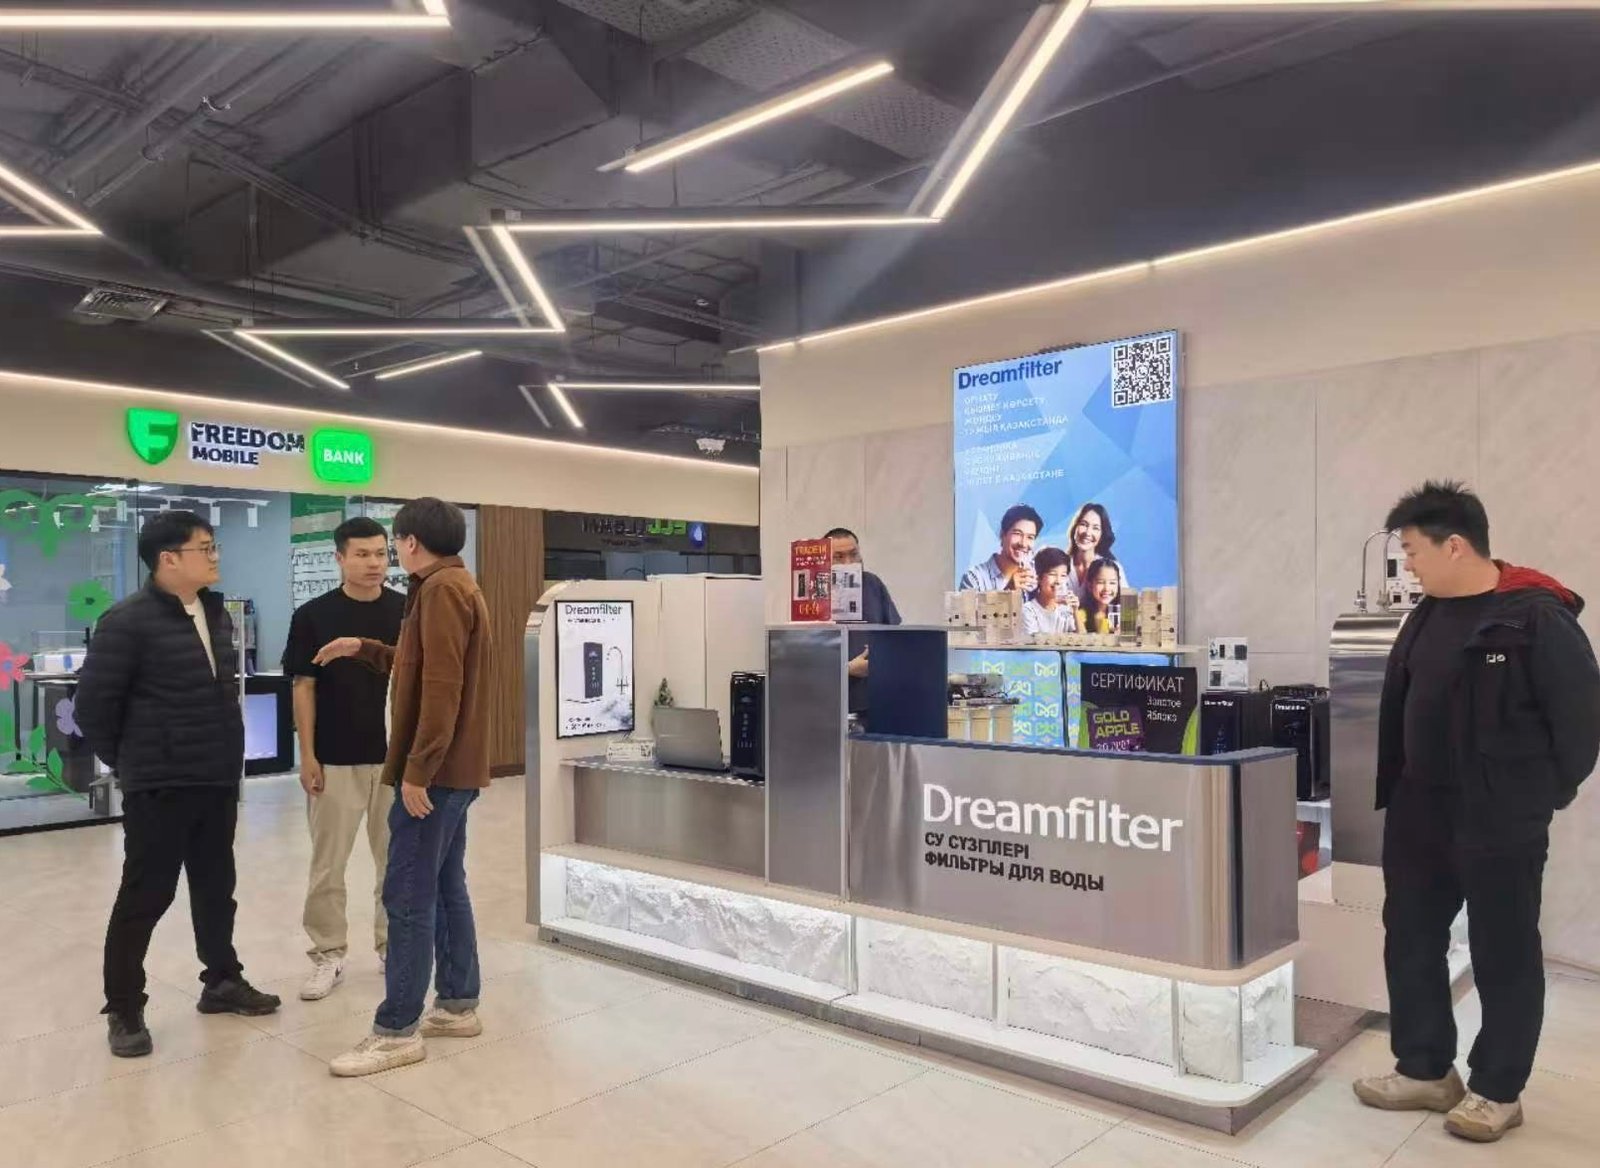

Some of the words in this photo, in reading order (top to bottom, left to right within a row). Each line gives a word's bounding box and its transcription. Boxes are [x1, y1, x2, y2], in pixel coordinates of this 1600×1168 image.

[958, 360, 1062, 389] Dreamfilter
[191, 422, 305, 452] FREEDOM
[192, 446, 259, 465] MOBILE
[323, 449, 365, 466] BANK
[565, 604, 623, 615] Dreamfilter
[1091, 672, 1184, 692] СЕРТИФИКАТ
[1093, 710, 1130, 724] GOLD
[1096, 723, 1140, 739] APPLE
[923, 783, 1183, 851] Dreamfilter
[925, 832, 944, 846] СУ
[925, 851, 1004, 876] ФИЛЬТРЫ
[1008, 863, 1044, 882] ДЛЯ
[1050, 869, 1104, 891] ВОДЫ
